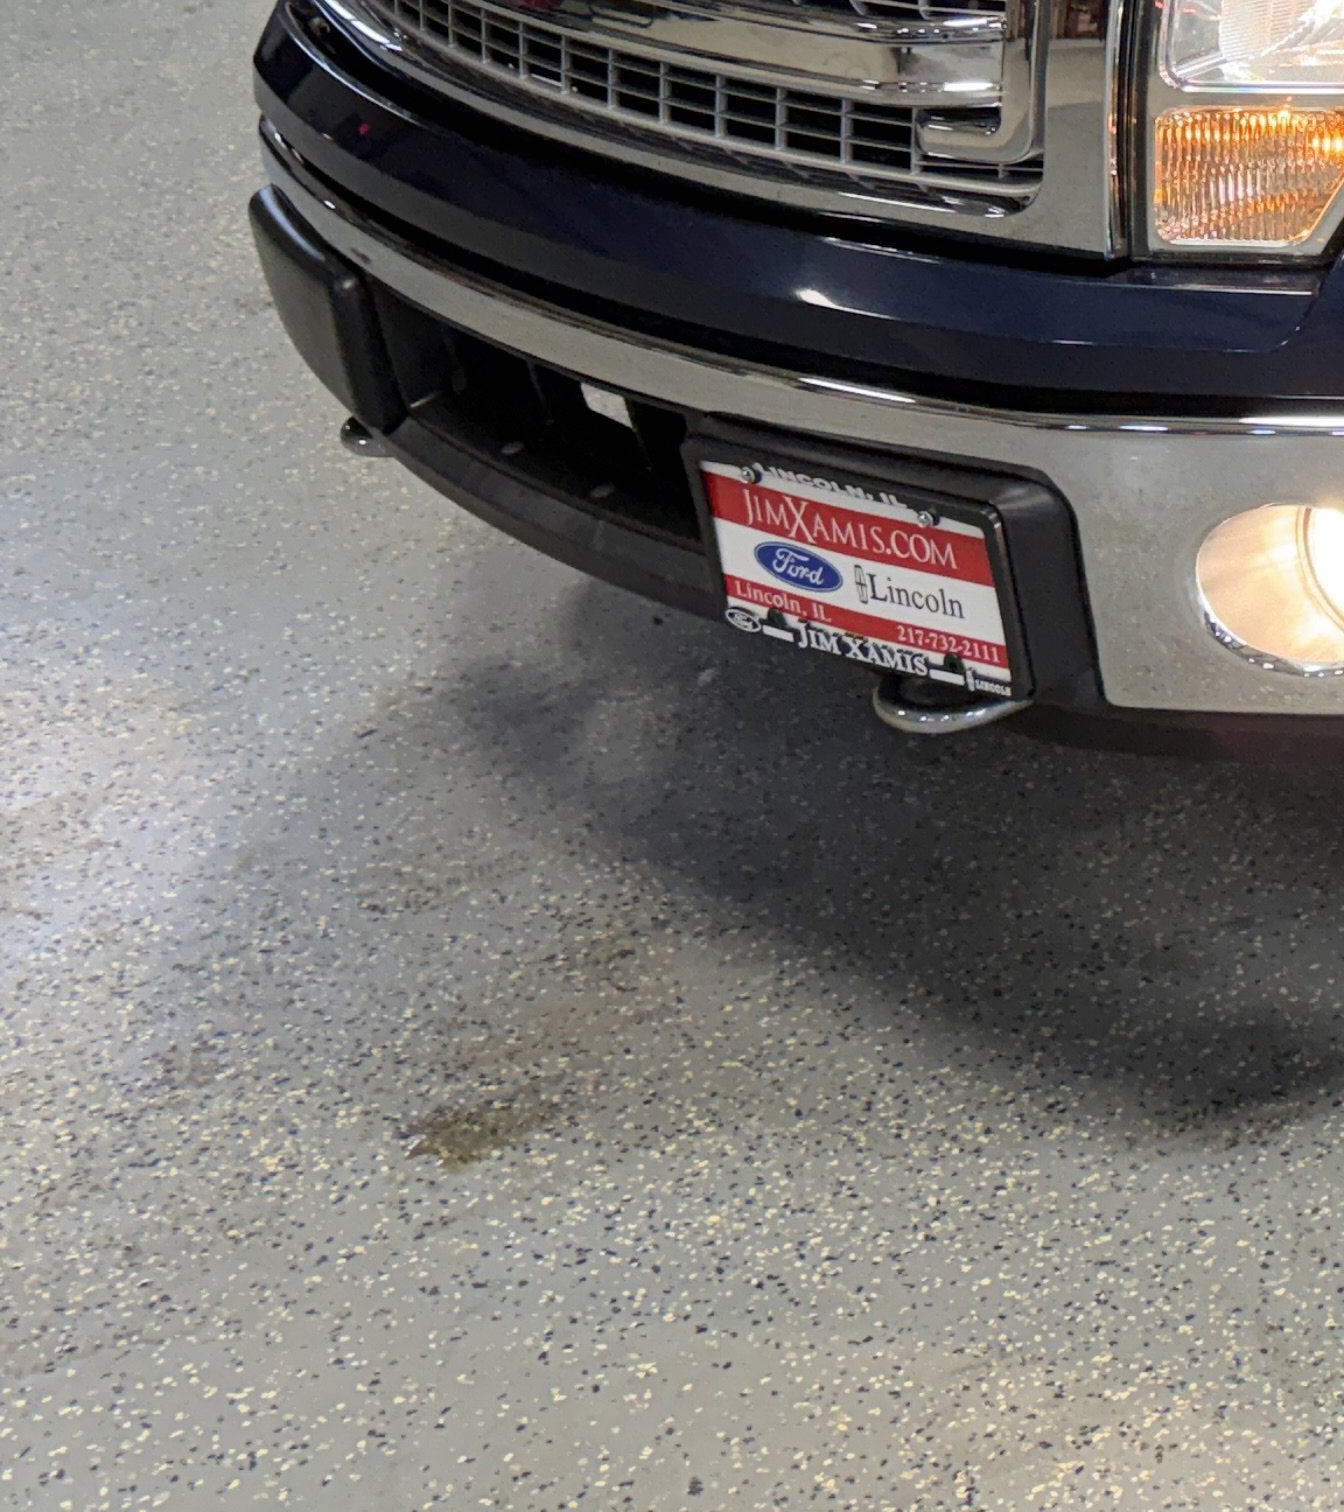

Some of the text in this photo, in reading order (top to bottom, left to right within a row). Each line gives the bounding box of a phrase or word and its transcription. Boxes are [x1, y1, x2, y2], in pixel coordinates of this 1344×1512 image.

[743, 489, 959, 570] JIMXAMIS.COM
[772, 547, 824, 585] Ford
[812, 603, 832, 622] IL
[867, 573, 966, 619] Lincoln
[798, 622, 929, 676] JIM XAMIS
[897, 625, 1000, 662] 217-732-2111
